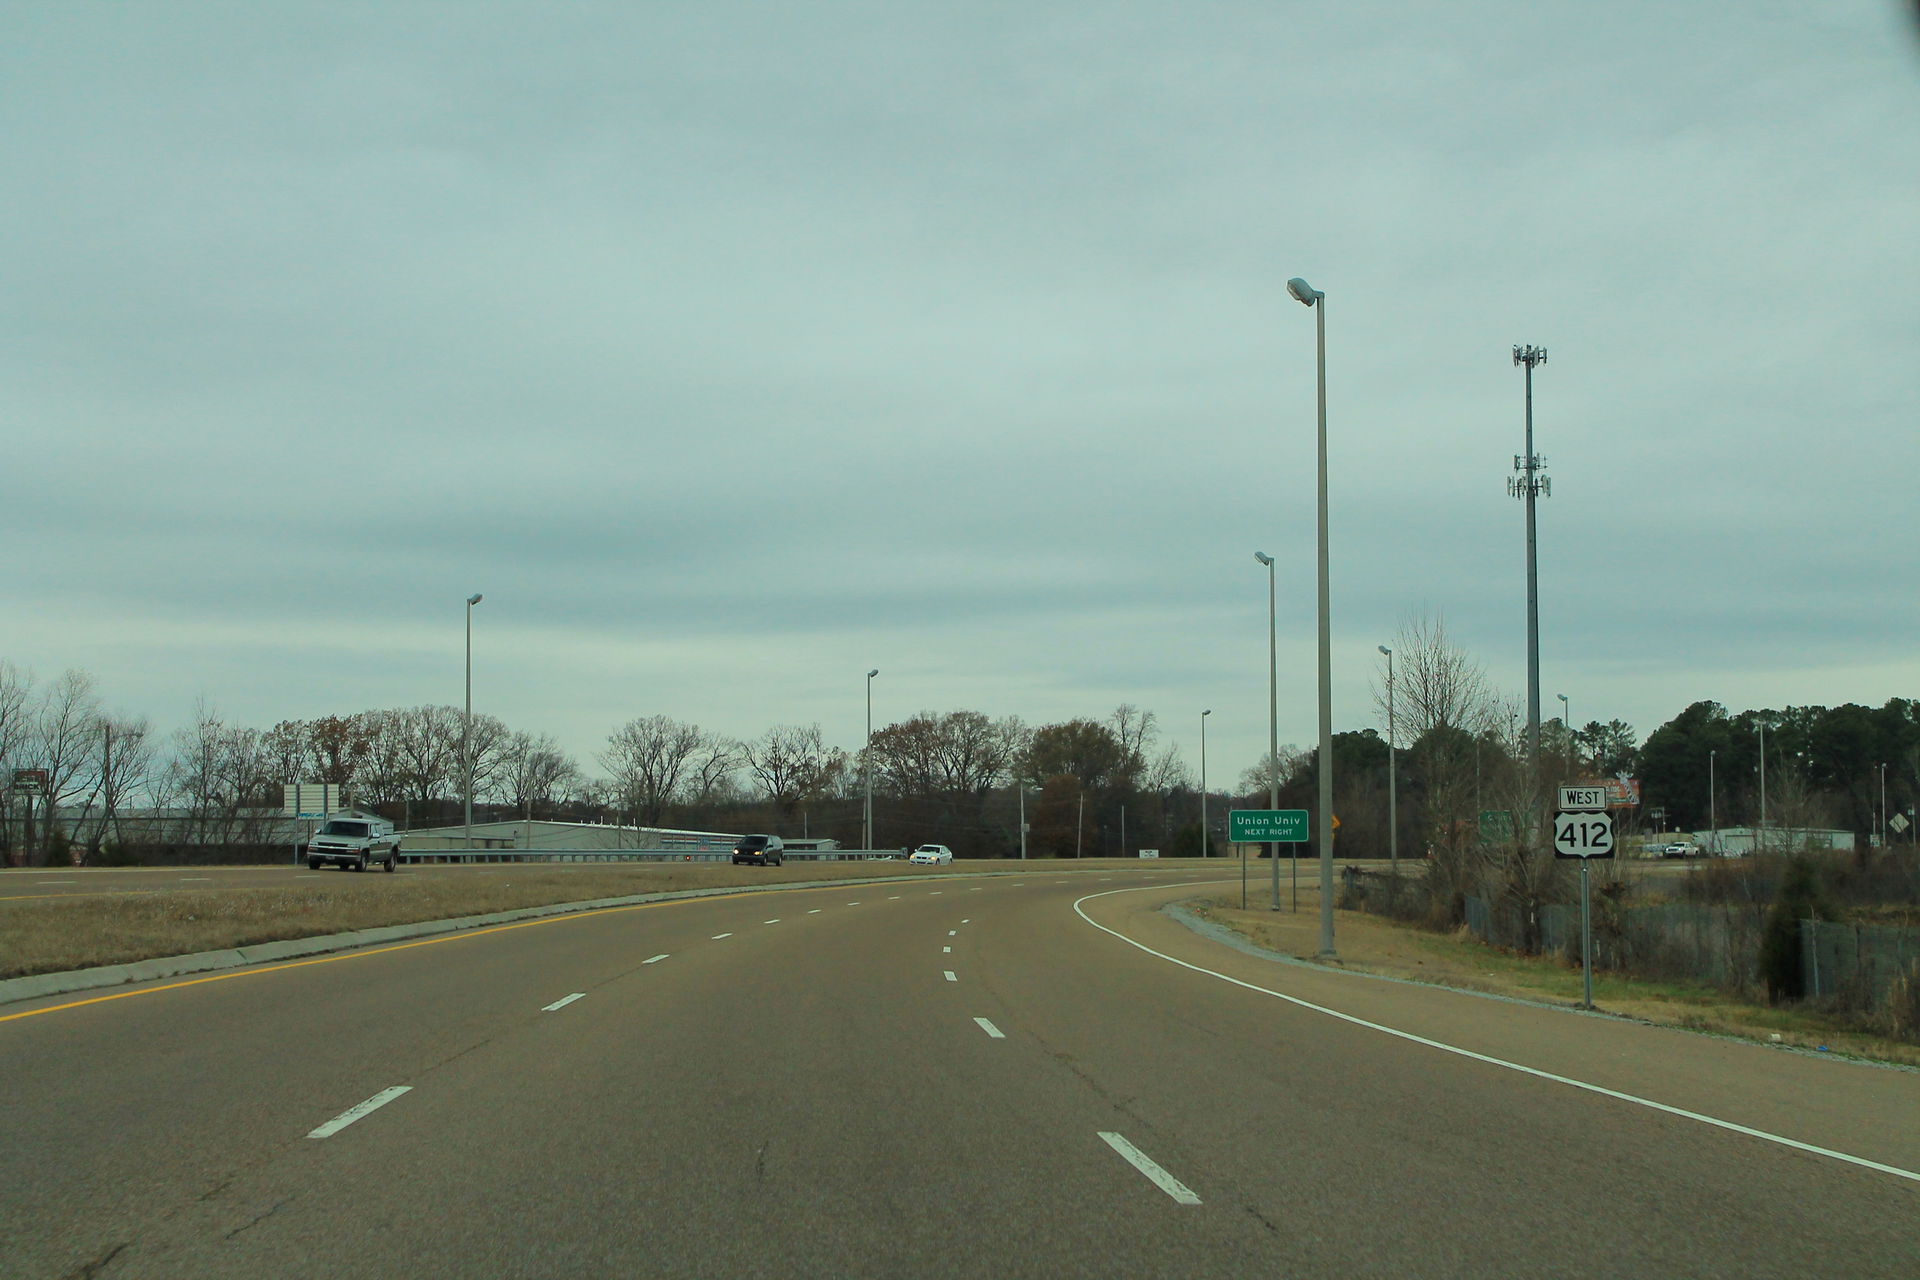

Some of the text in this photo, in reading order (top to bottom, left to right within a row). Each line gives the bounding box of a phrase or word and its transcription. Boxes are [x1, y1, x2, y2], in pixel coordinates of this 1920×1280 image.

[1566, 791, 1599, 804] WEST
[1237, 816, 1300, 825] Union Univ
[1244, 828, 1293, 836] NEXT RIGHT
[1558, 822, 1608, 847] 412
